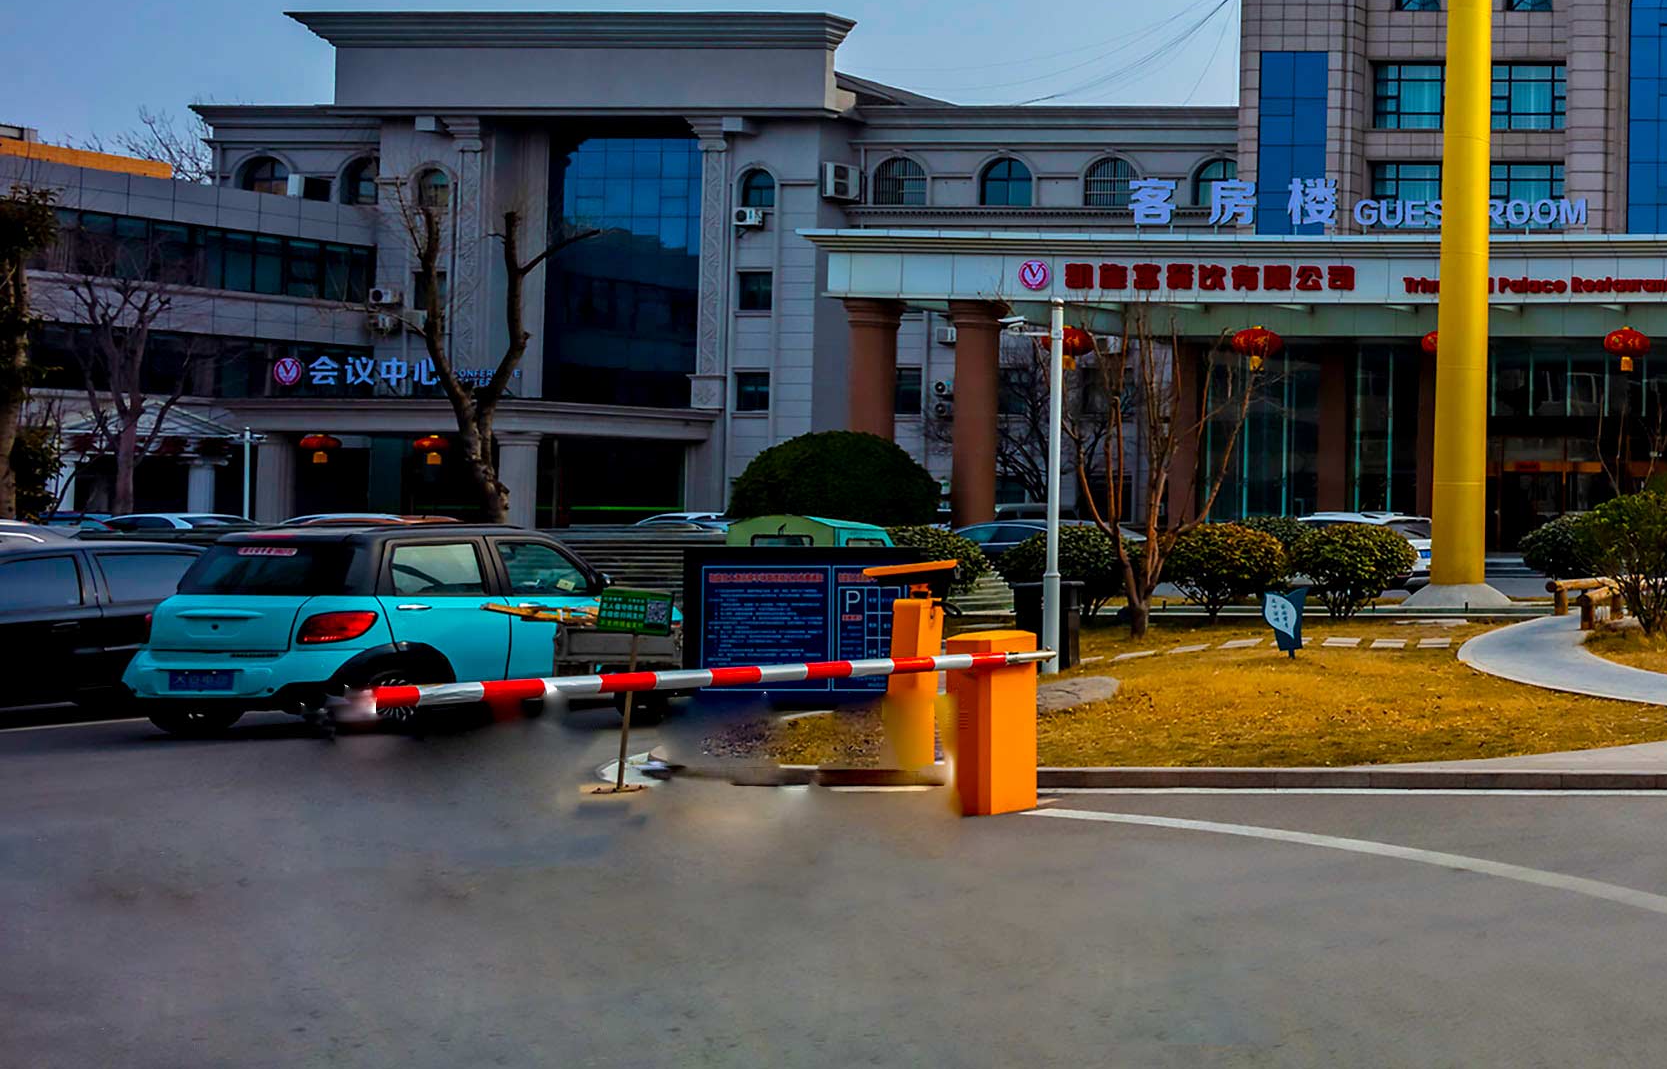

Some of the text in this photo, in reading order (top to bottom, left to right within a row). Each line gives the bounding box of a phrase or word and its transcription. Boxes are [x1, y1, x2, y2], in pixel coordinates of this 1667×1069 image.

[1128, 178, 1337, 225] 客房楼
[1353, 198, 1442, 226] GUES
[309, 356, 441, 386] 会议中心
